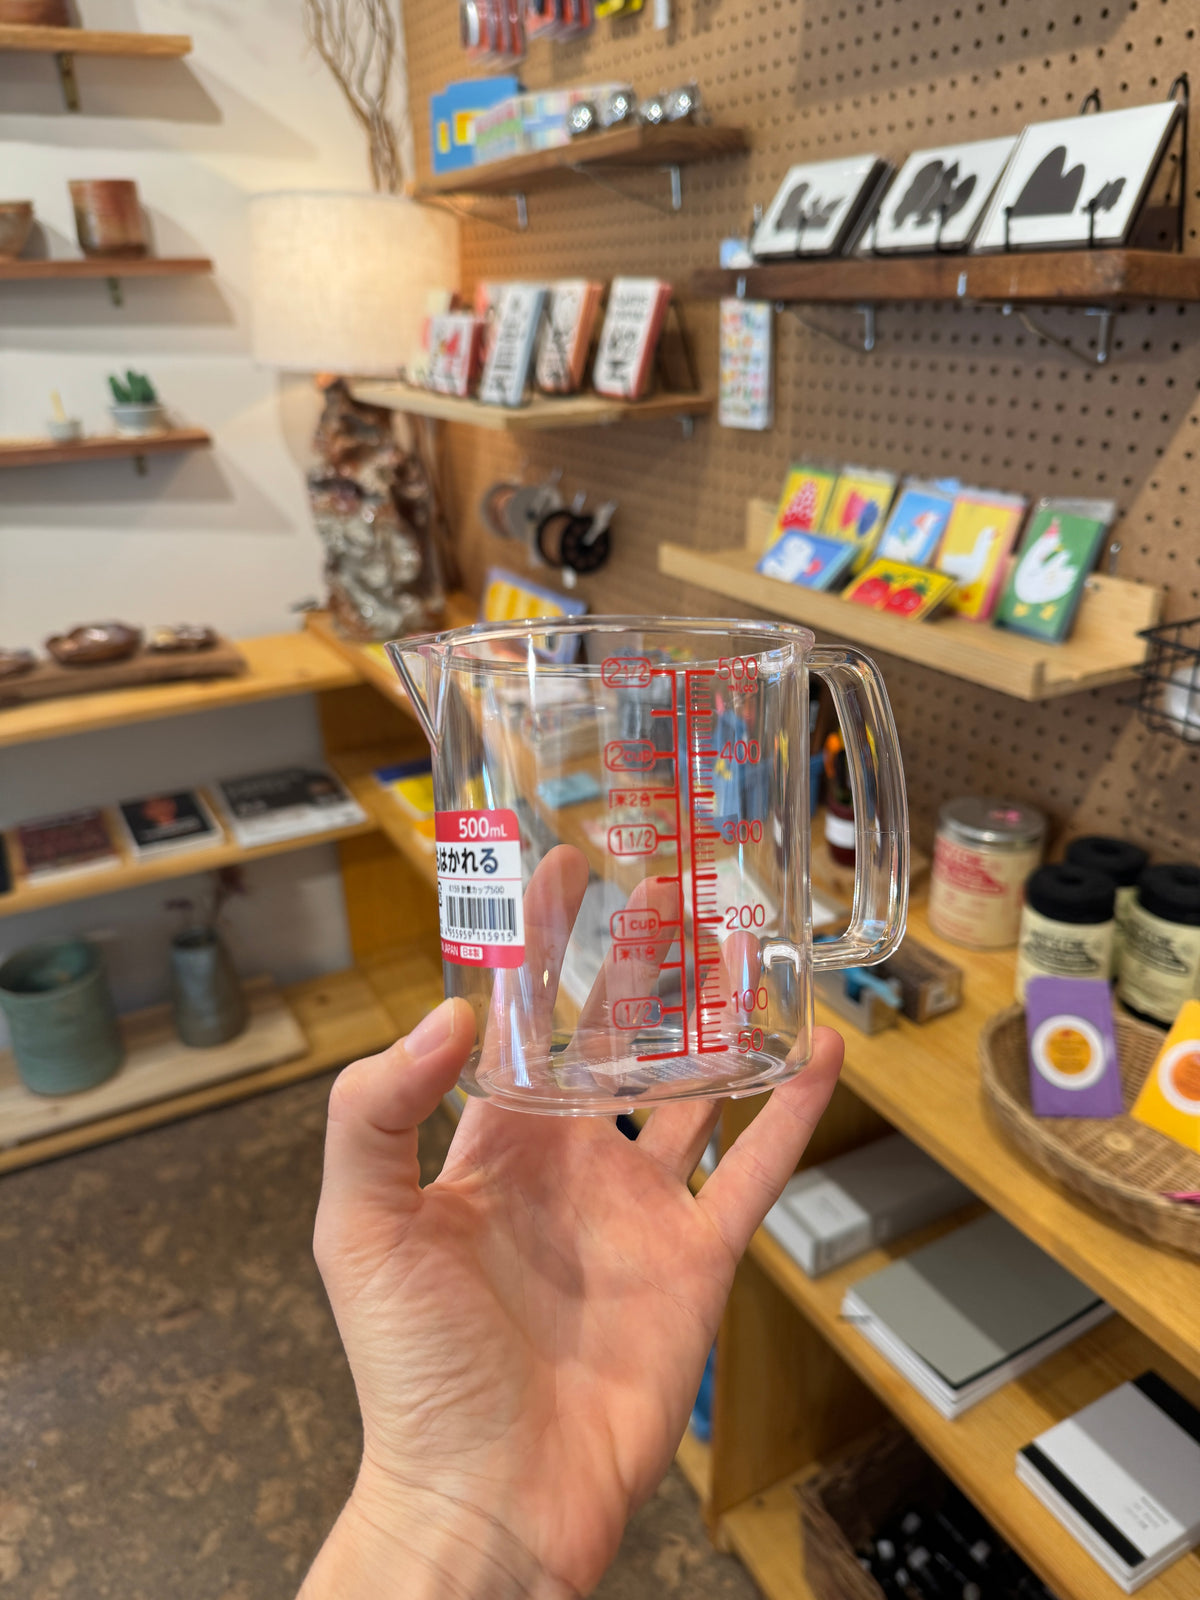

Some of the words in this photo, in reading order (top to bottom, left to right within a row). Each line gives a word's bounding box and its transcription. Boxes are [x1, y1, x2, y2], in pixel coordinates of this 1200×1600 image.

[717, 657, 758, 681] 500
[720, 739, 761, 764] 400
[459, 817, 508, 839] 500mL
[722, 819, 763, 845] 300
[629, 917, 657, 931] cup
[725, 904, 766, 930] 200
[732, 987, 769, 1013] 100
[624, 1002, 653, 1024] 1/2
[737, 1028, 764, 1054] 50
